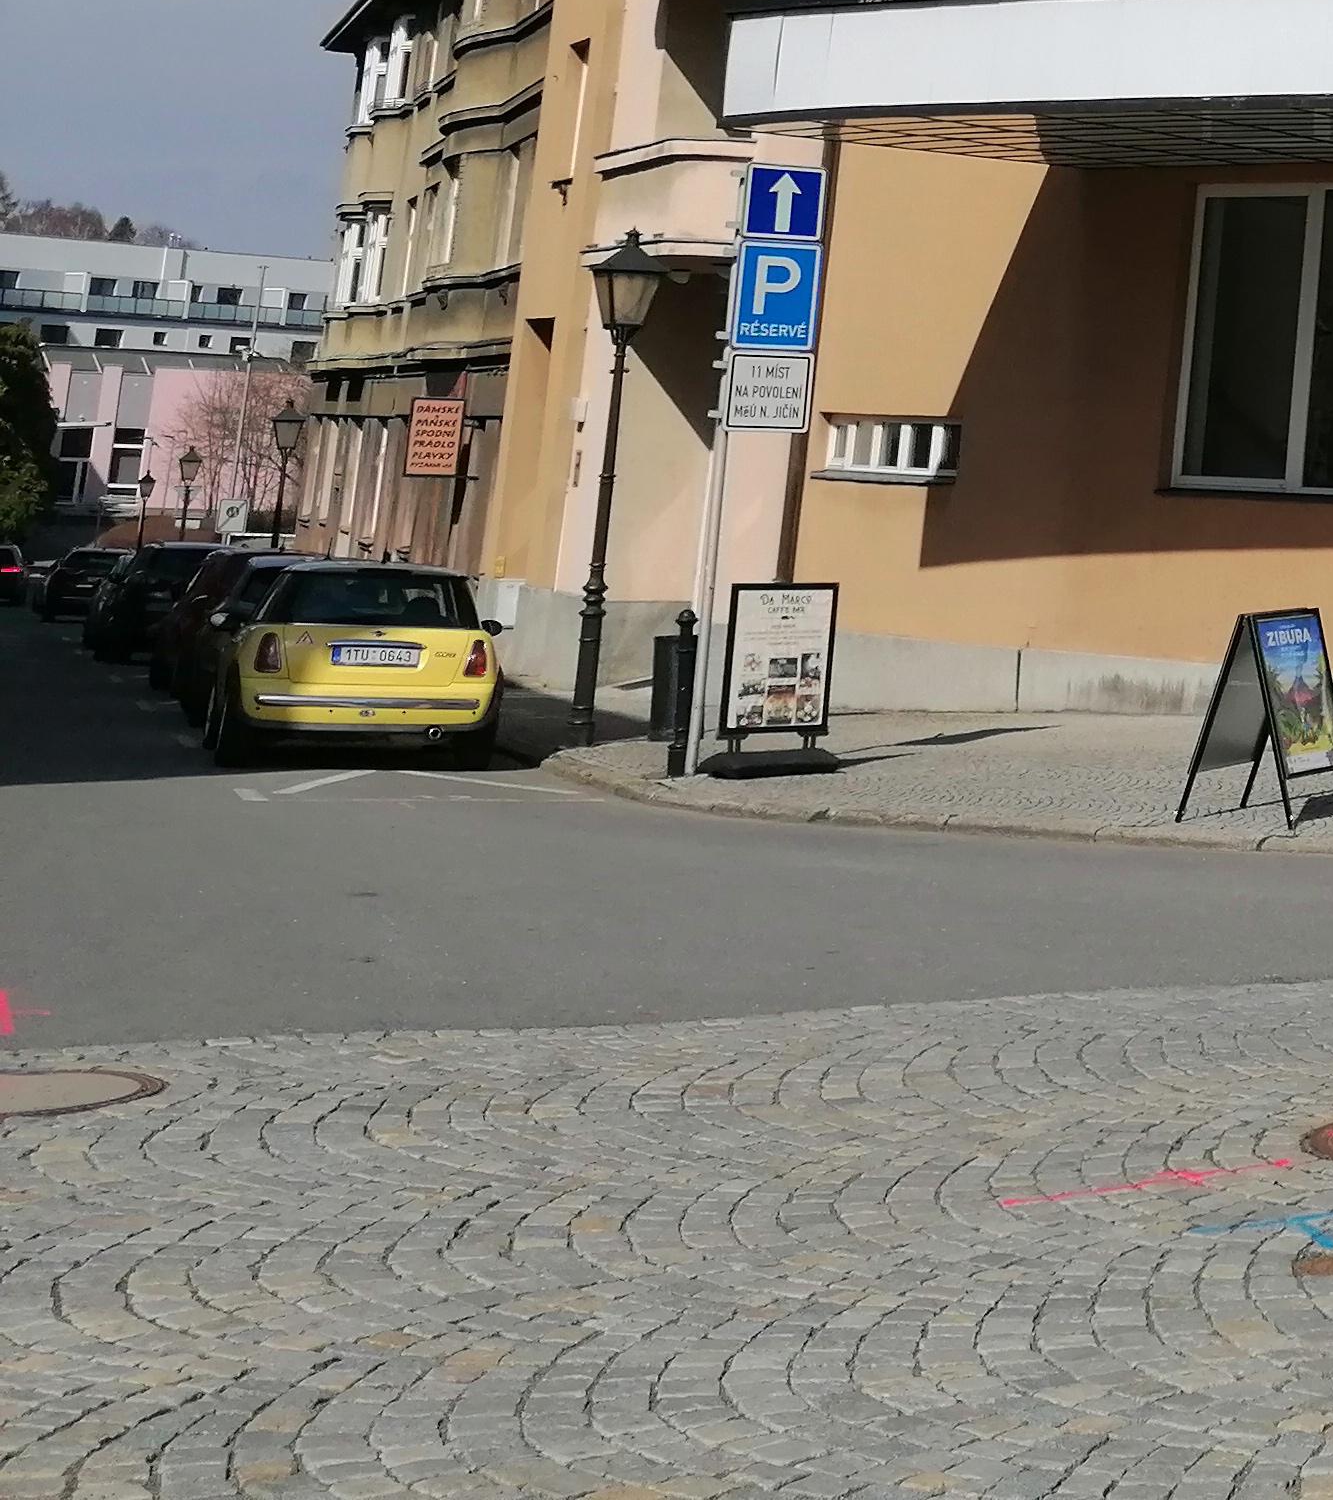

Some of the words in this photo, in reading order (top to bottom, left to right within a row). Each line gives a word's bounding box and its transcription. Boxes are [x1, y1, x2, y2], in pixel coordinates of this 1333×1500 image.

[752, 255, 802, 315] P
[739, 319, 807, 338] RÉSERVÉ
[752, 366, 761, 378] 11
[765, 364, 790, 379] MÍST
[735, 385, 749, 397] NA
[752, 385, 803, 399] POVOLENÍ
[772, 404, 799, 419] JIČÍN
[1265, 628, 1312, 647] ZIBURA
[345, 649, 369, 661] 1TU
[379, 649, 412, 662] 0643
